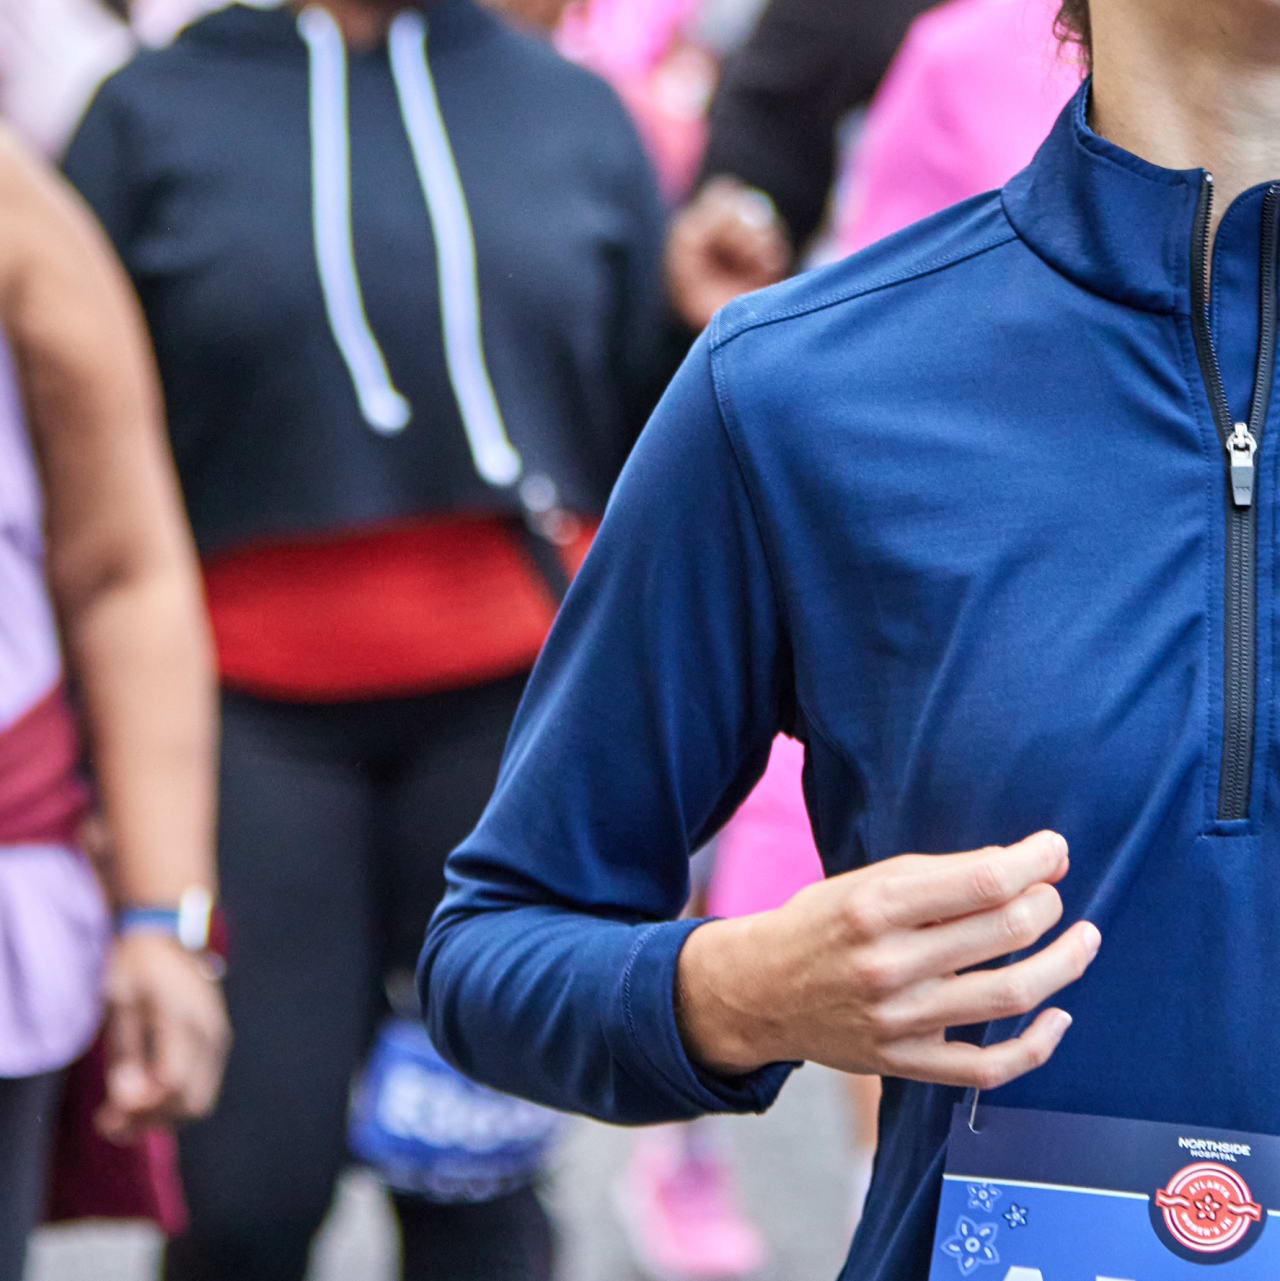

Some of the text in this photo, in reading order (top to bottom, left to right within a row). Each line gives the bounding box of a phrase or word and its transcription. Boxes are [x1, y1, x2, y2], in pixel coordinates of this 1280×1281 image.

[1178, 1137, 1250, 1156] NORTHSIDE
[1190, 1149, 1237, 1162] HOSPITAL
[1188, 1179, 1231, 1199] ATLANTA
